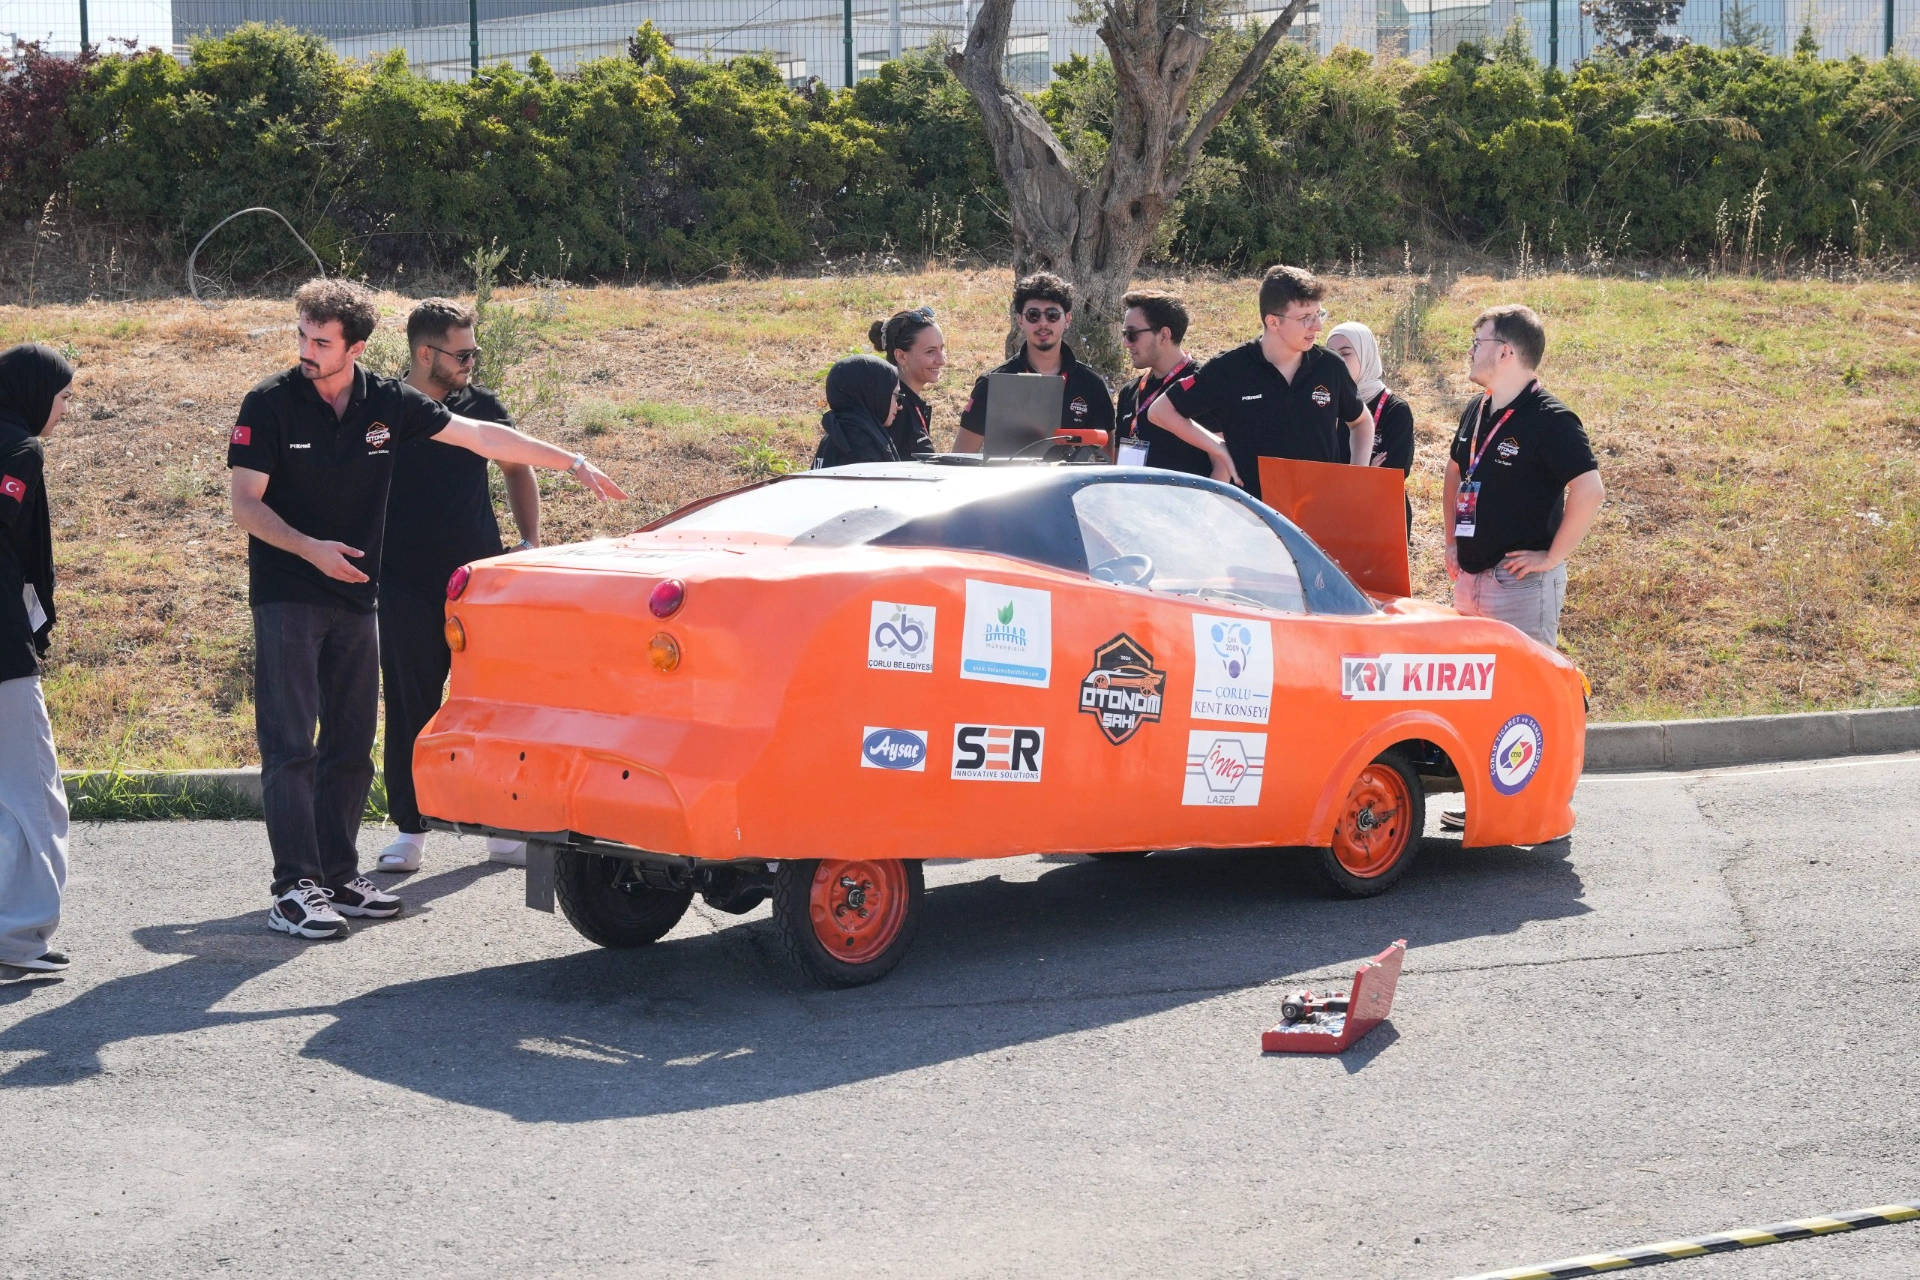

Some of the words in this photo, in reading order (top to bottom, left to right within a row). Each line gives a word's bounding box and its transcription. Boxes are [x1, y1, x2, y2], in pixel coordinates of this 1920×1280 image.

[985, 624, 1027, 647] BAHAR
[1225, 644, 1240, 652] 2009
[868, 660, 892, 668] ÇORLU
[893, 661, 932, 671] BELEDİYESİ
[1344, 662, 1393, 691] KRY
[1402, 662, 1495, 691] KIRAY
[1081, 686, 1162, 714] OTONOM
[1215, 686, 1252, 700] ÇORLU
[1194, 701, 1222, 714] KENT
[1224, 703, 1268, 718] KONSEYİ
[1102, 712, 1136, 729] ŞAHİ
[869, 735, 920, 763] Aysaç
[955, 726, 1041, 771] SER
[954, 770, 998, 778] INNOVATIVE
[1000, 771, 1039, 780] SOLUTIONS
[1206, 795, 1236, 804] LAZER
